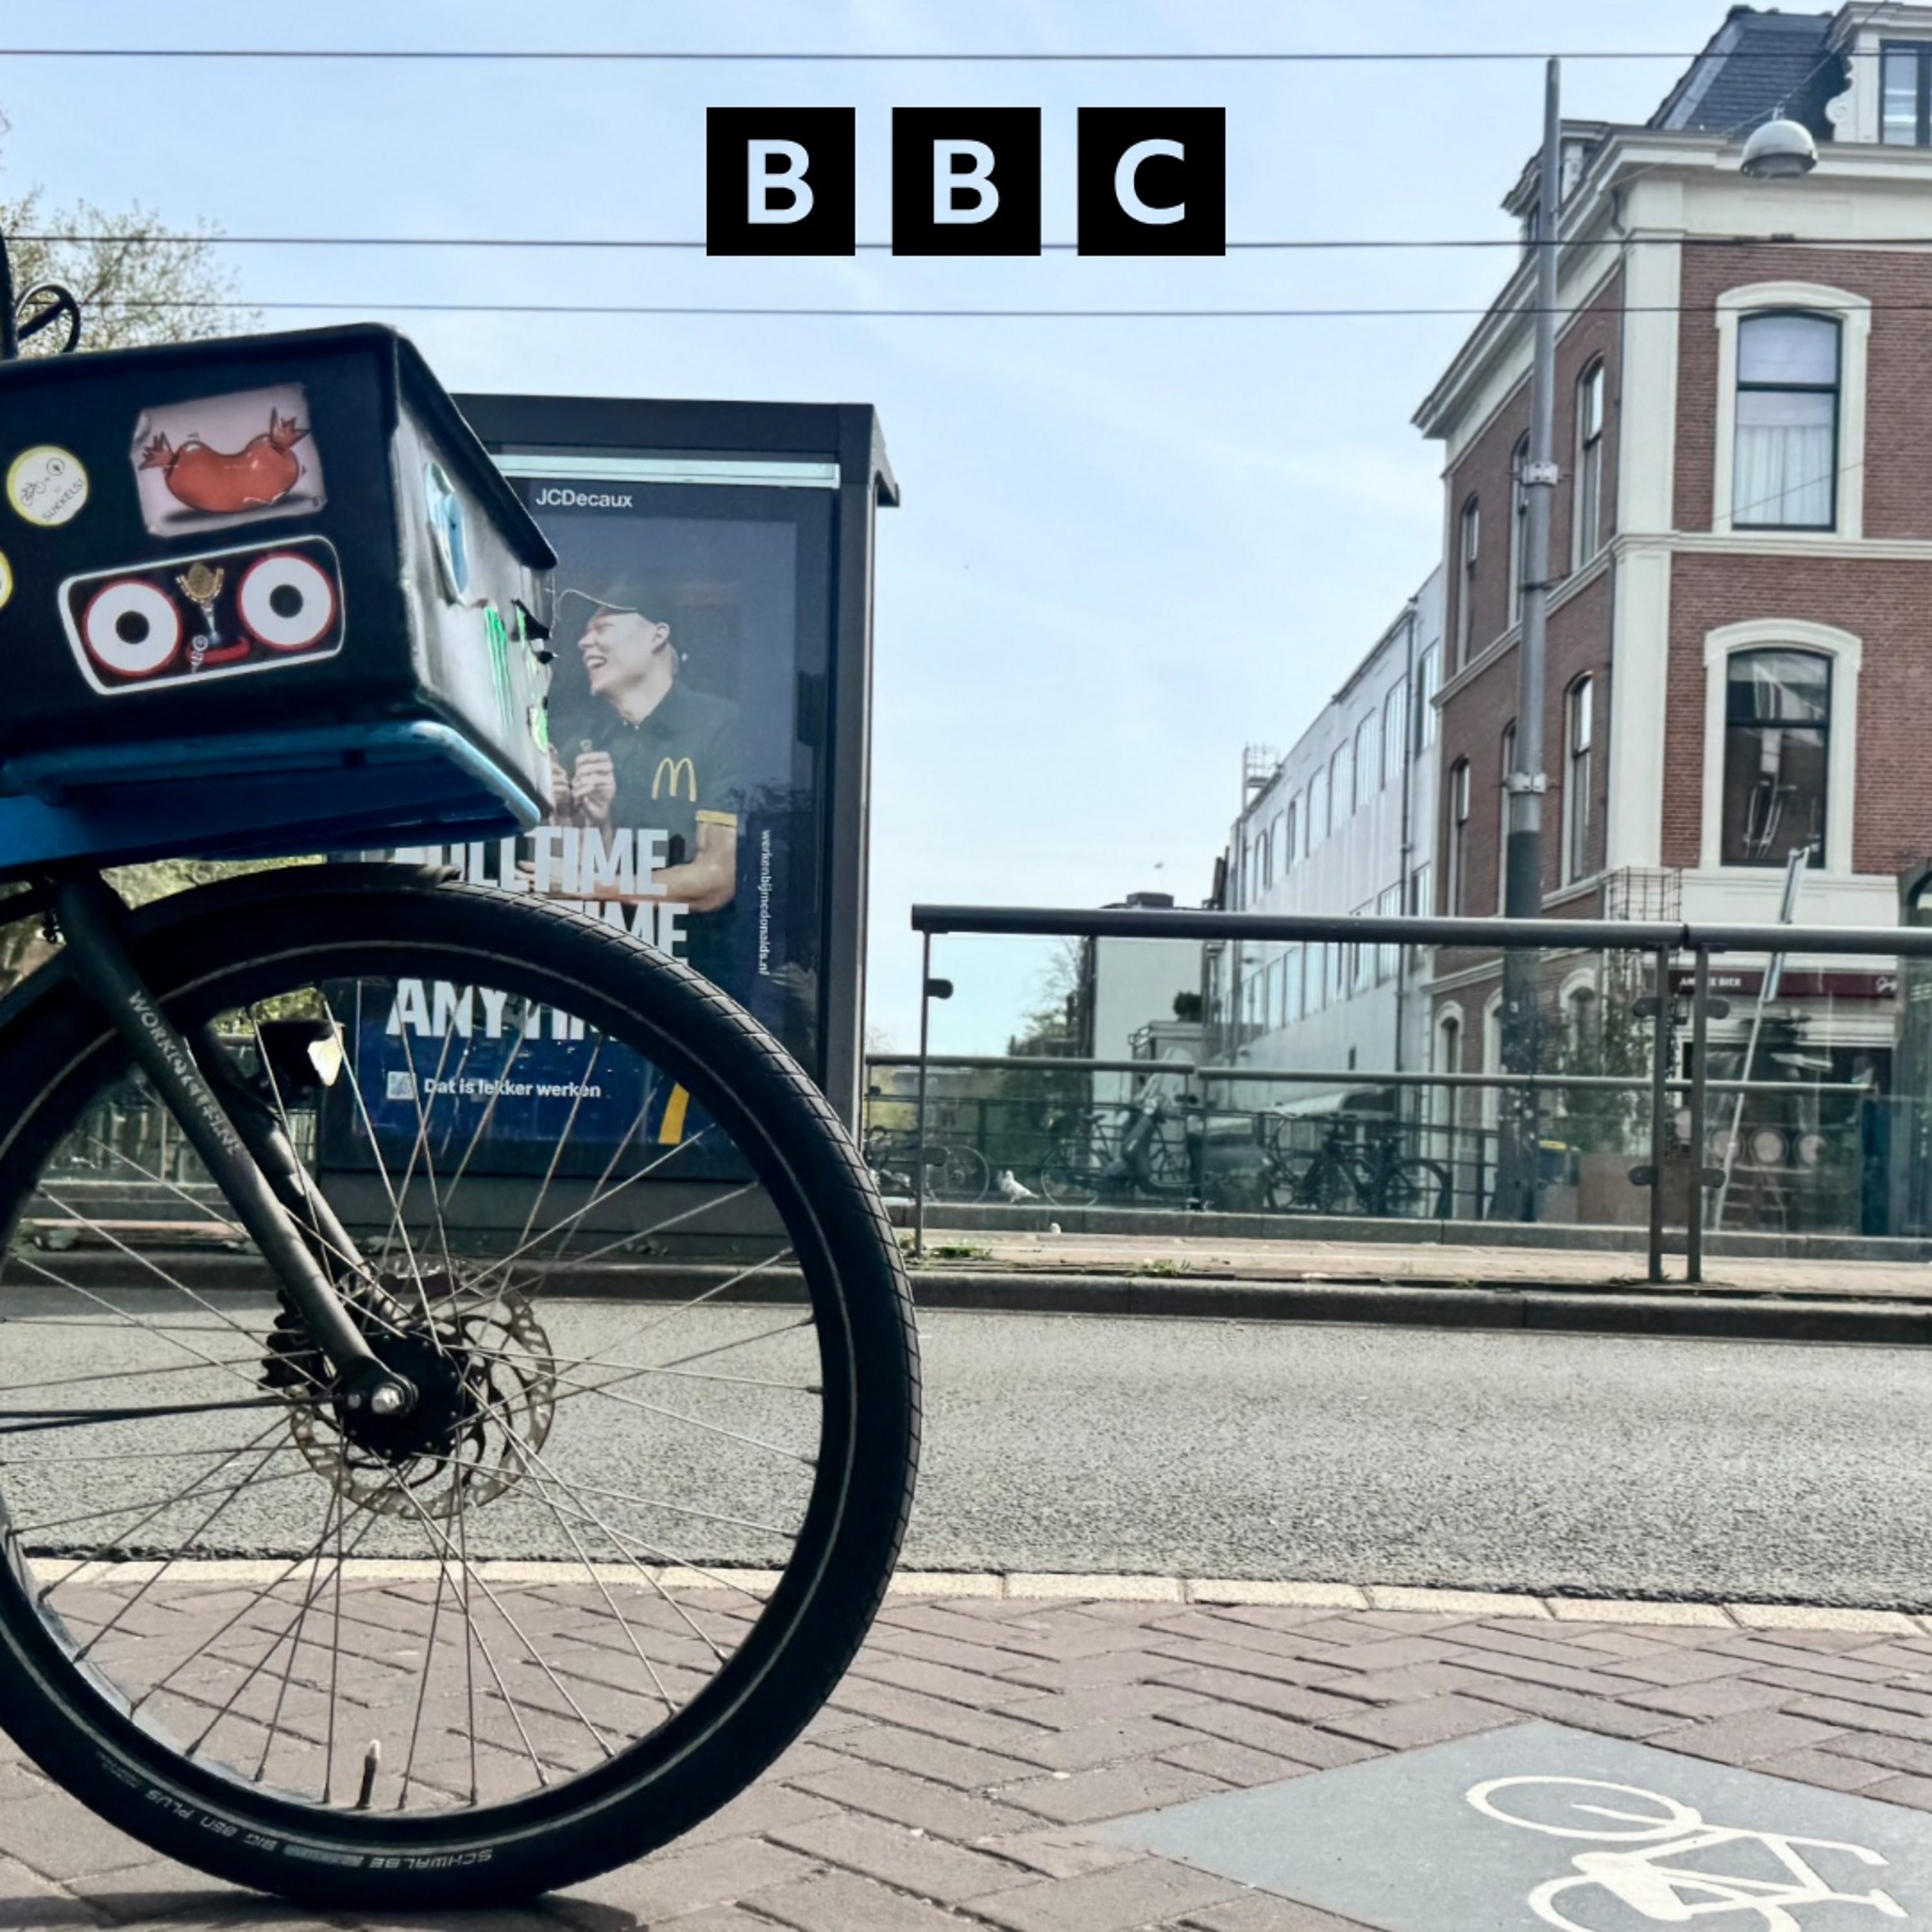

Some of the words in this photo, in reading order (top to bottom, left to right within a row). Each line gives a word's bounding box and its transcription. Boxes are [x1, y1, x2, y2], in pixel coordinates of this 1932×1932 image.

[536, 488, 632, 508] JCDecaux
[652, 757, 697, 802] M
[395, 826, 668, 895] LLTIME
[758, 829, 772, 976] werkenbijmcdonalds.nl
[424, 1078, 457, 1094] Dat
[460, 1077, 474, 1094] is
[478, 1079, 532, 1095] lekker
[536, 1082, 601, 1097] werken
[144, 1790, 195, 1819] PLUS
[245, 1833, 279, 1852] BIG
[368, 1849, 493, 1869] SCHWALBE
